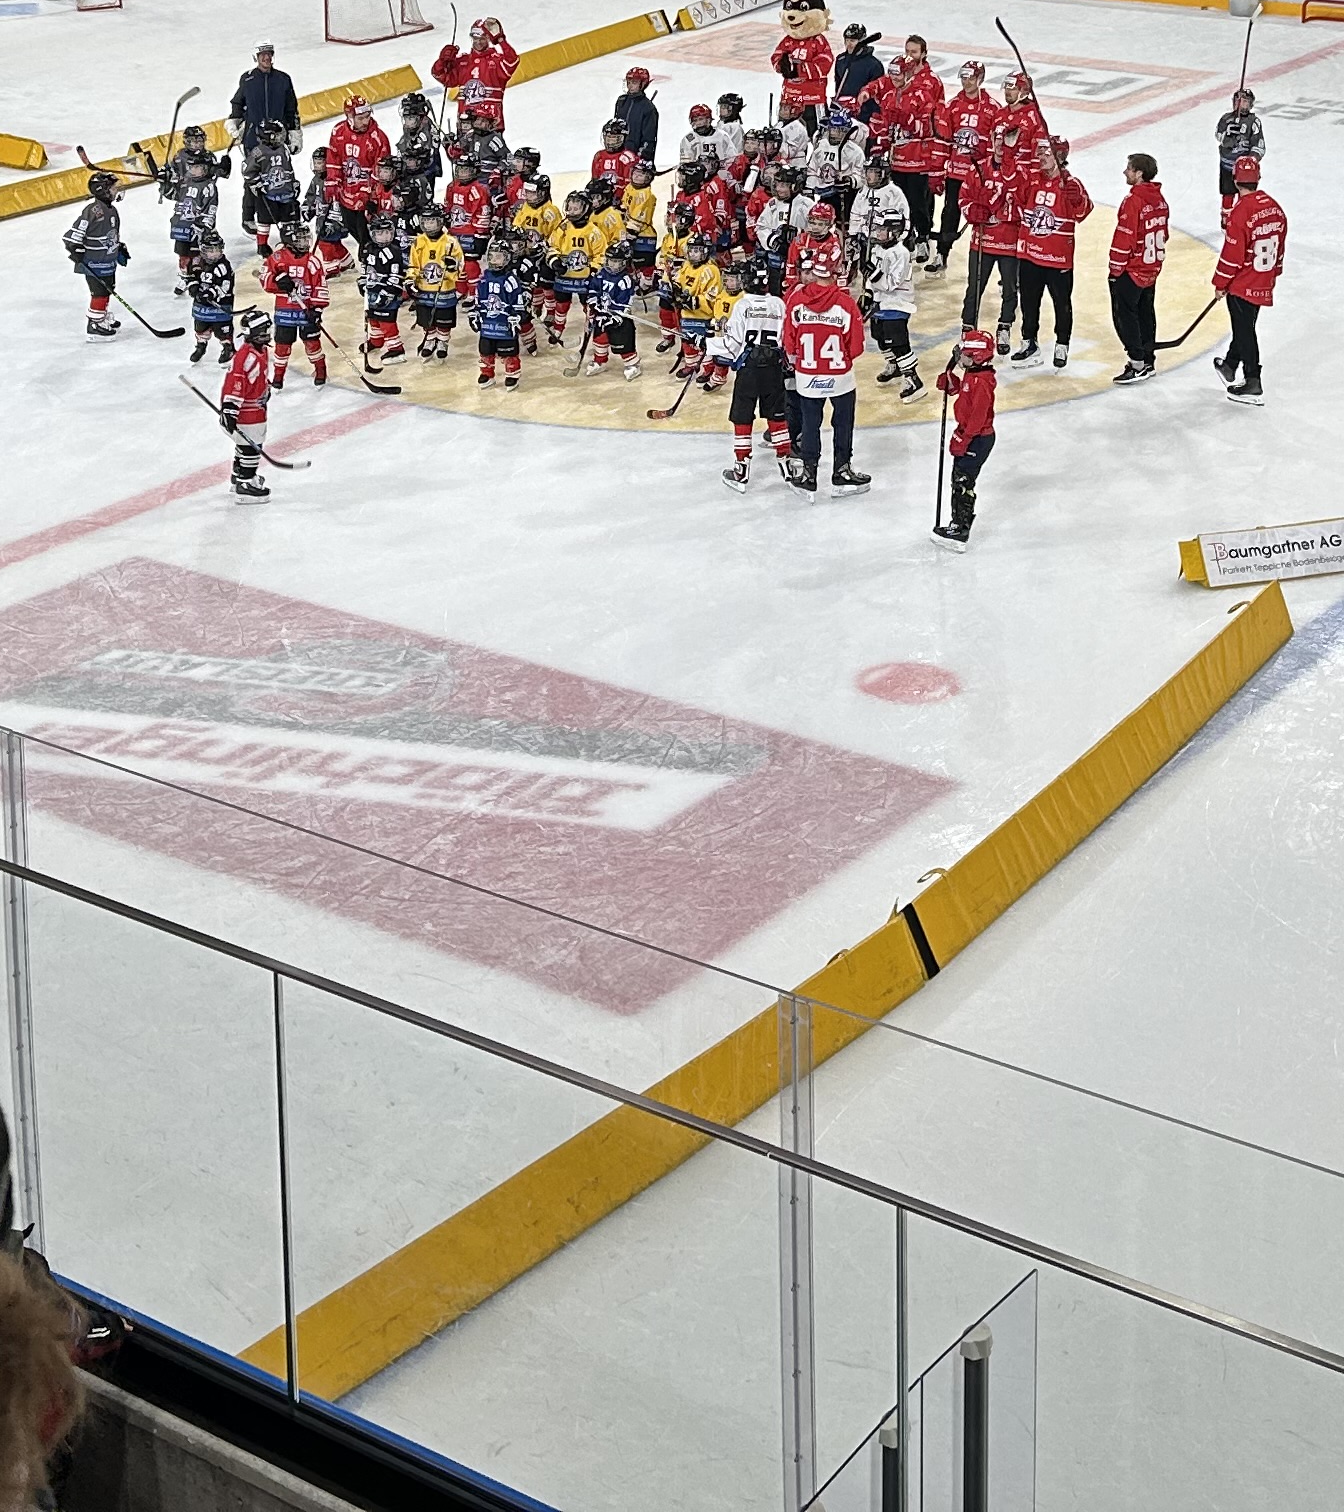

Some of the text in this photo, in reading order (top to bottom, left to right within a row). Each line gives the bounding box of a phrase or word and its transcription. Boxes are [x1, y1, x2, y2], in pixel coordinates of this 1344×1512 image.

[471, 67, 479, 79] 4
[960, 114, 978, 127] 26
[270, 155, 283, 166] 12
[823, 152, 836, 162] 70
[1035, 190, 1057, 207] 69
[571, 236, 585, 248] 10
[289, 265, 305, 278] 59
[799, 333, 847, 369] 14
[1210, 534, 1343, 565] Baumgartner AG
